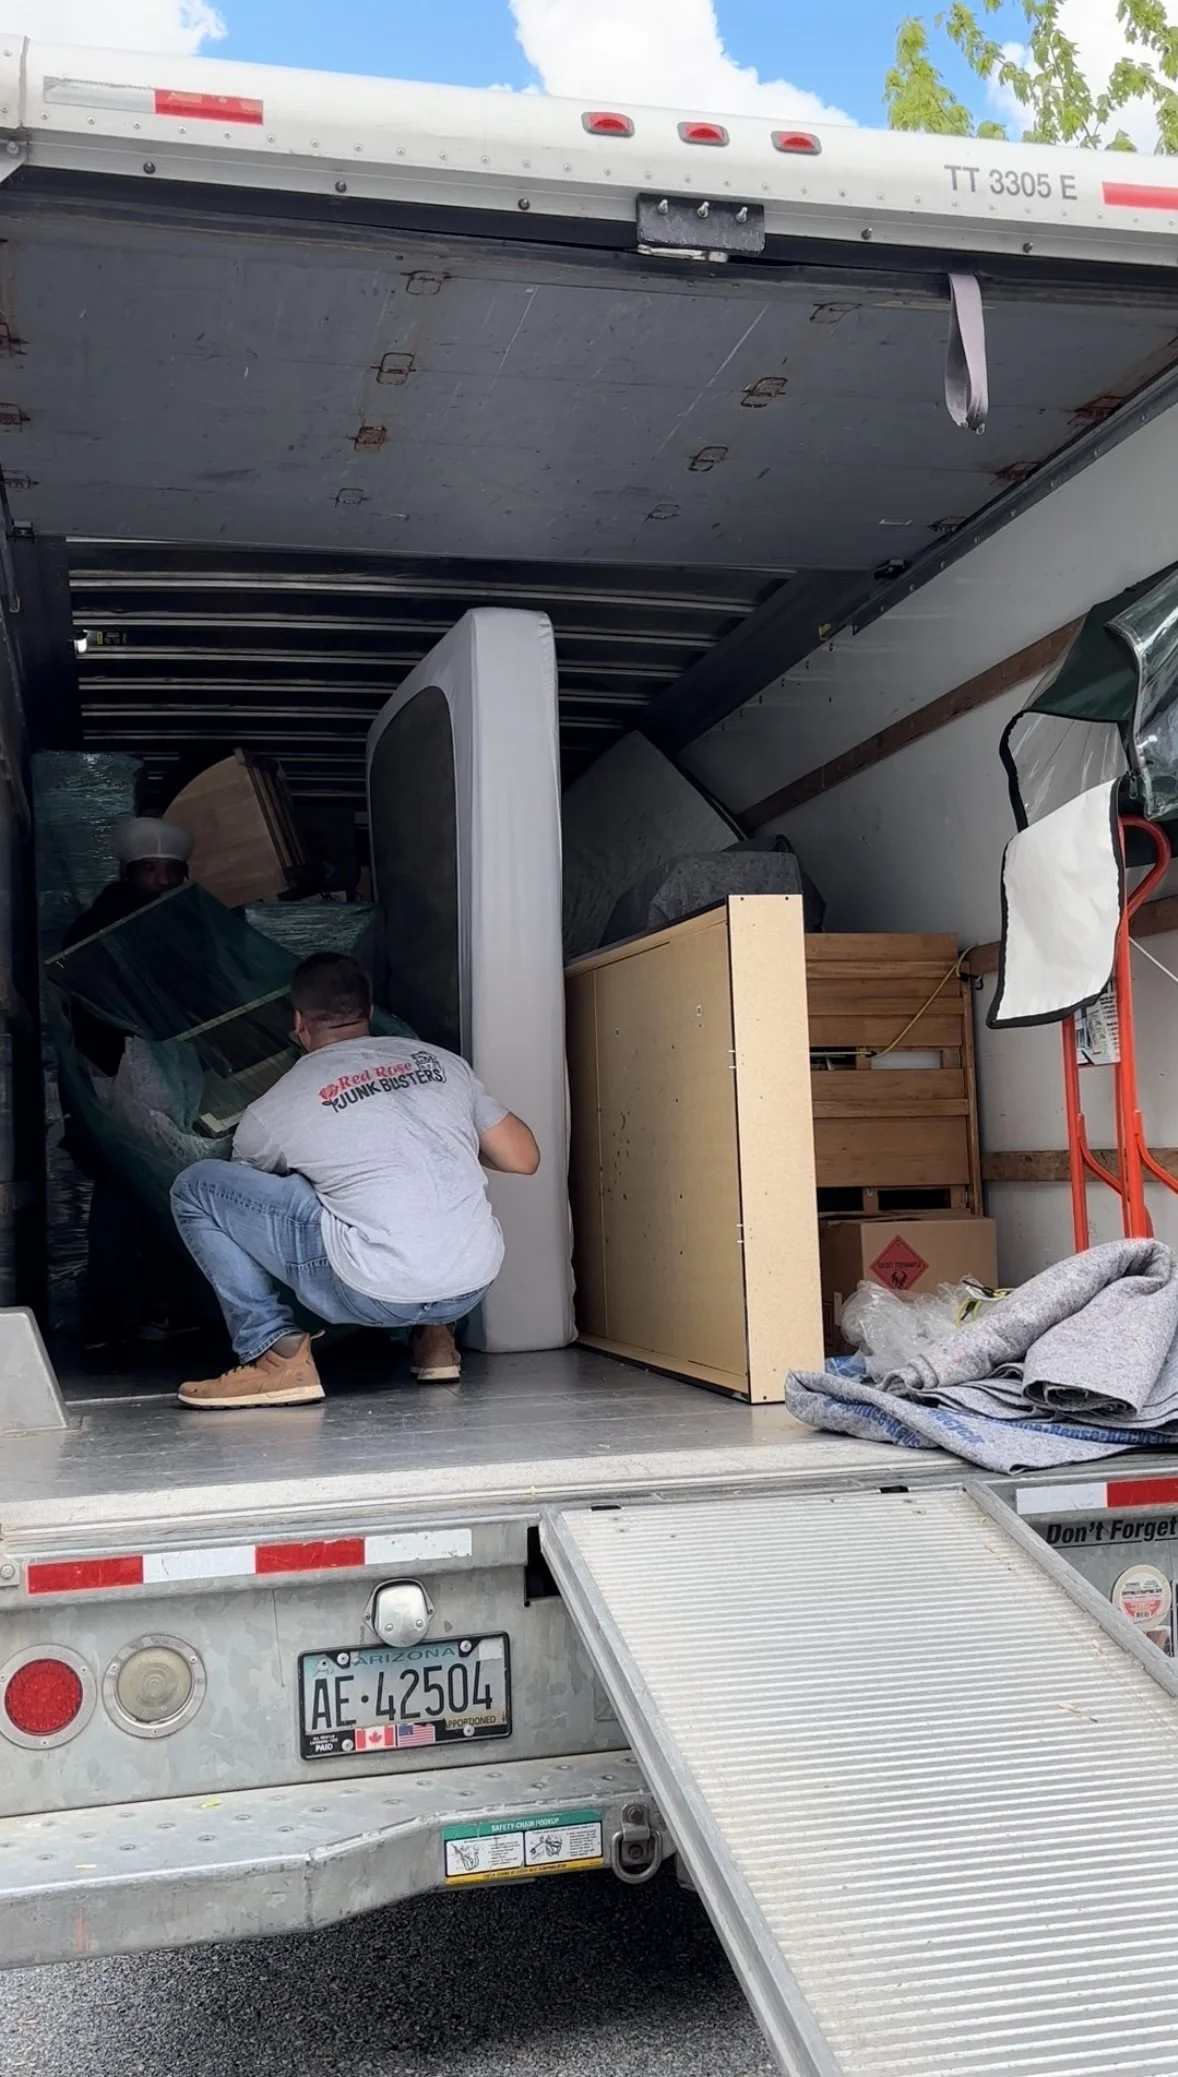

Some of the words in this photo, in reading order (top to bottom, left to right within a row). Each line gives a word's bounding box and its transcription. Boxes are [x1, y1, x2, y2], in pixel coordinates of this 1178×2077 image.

[944, 164, 980, 193] TT
[989, 169, 1051, 199] 3305
[1060, 174, 1077, 200] E
[337, 1069, 371, 1091] Red
[375, 1061, 412, 1078] Rose
[337, 1081, 382, 1109] JUNK
[380, 1069, 443, 1093] BUSTERS
[1046, 1521, 1104, 1545] Don't
[1110, 1516, 1178, 1542] Forget
[353, 1647, 456, 1667] ARIZONA
[315, 1743, 333, 1753] PAID
